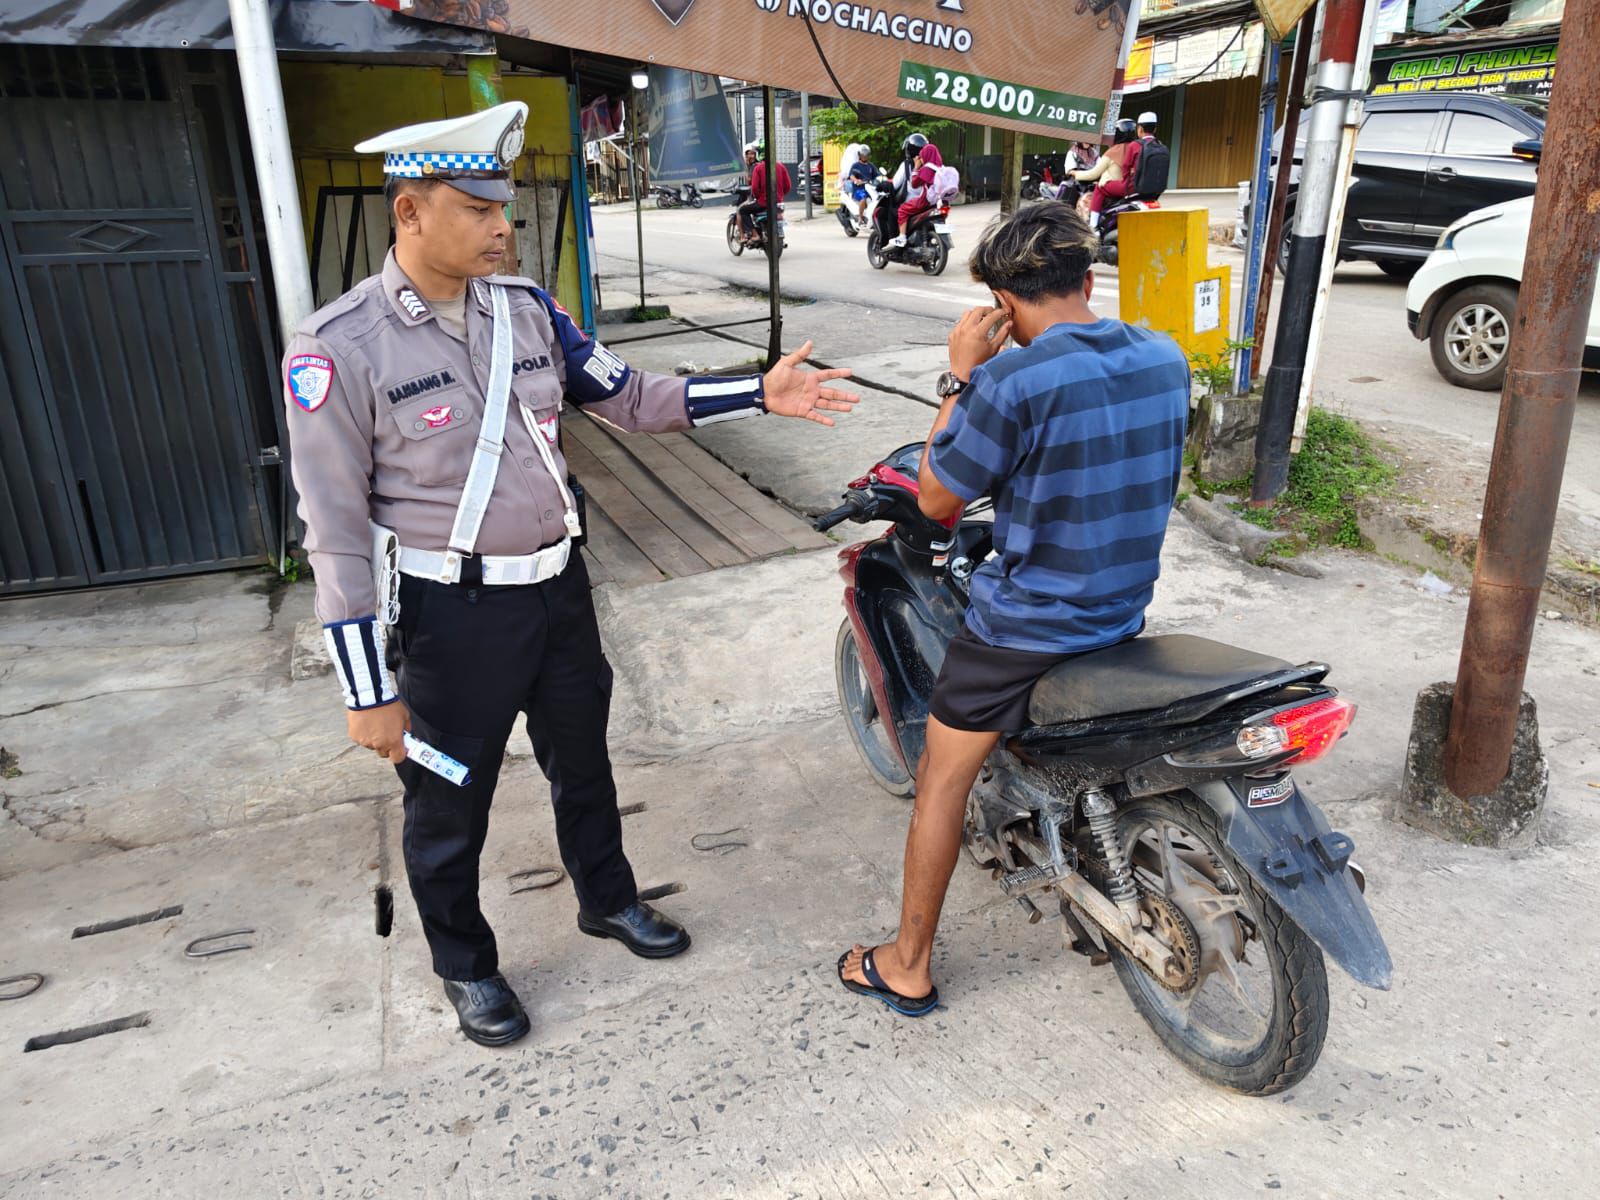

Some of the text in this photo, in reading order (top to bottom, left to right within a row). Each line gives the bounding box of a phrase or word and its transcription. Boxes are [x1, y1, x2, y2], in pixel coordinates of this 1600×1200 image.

[788, 0, 972, 52] MOCHACCINO
[1389, 55, 1459, 81] AQILA
[1397, 81, 1420, 92] BELI
[1421, 79, 1436, 90] HP
[1437, 75, 1481, 89] SECOND
[1481, 72, 1505, 84] DAN
[1506, 68, 1549, 82] TUKAR
[906, 76, 928, 94] RP.
[931, 72, 1034, 116] 28.000
[1047, 105, 1065, 120] 20
[1067, 110, 1097, 125] BTG
[387, 375, 441, 404] BAMBANG
